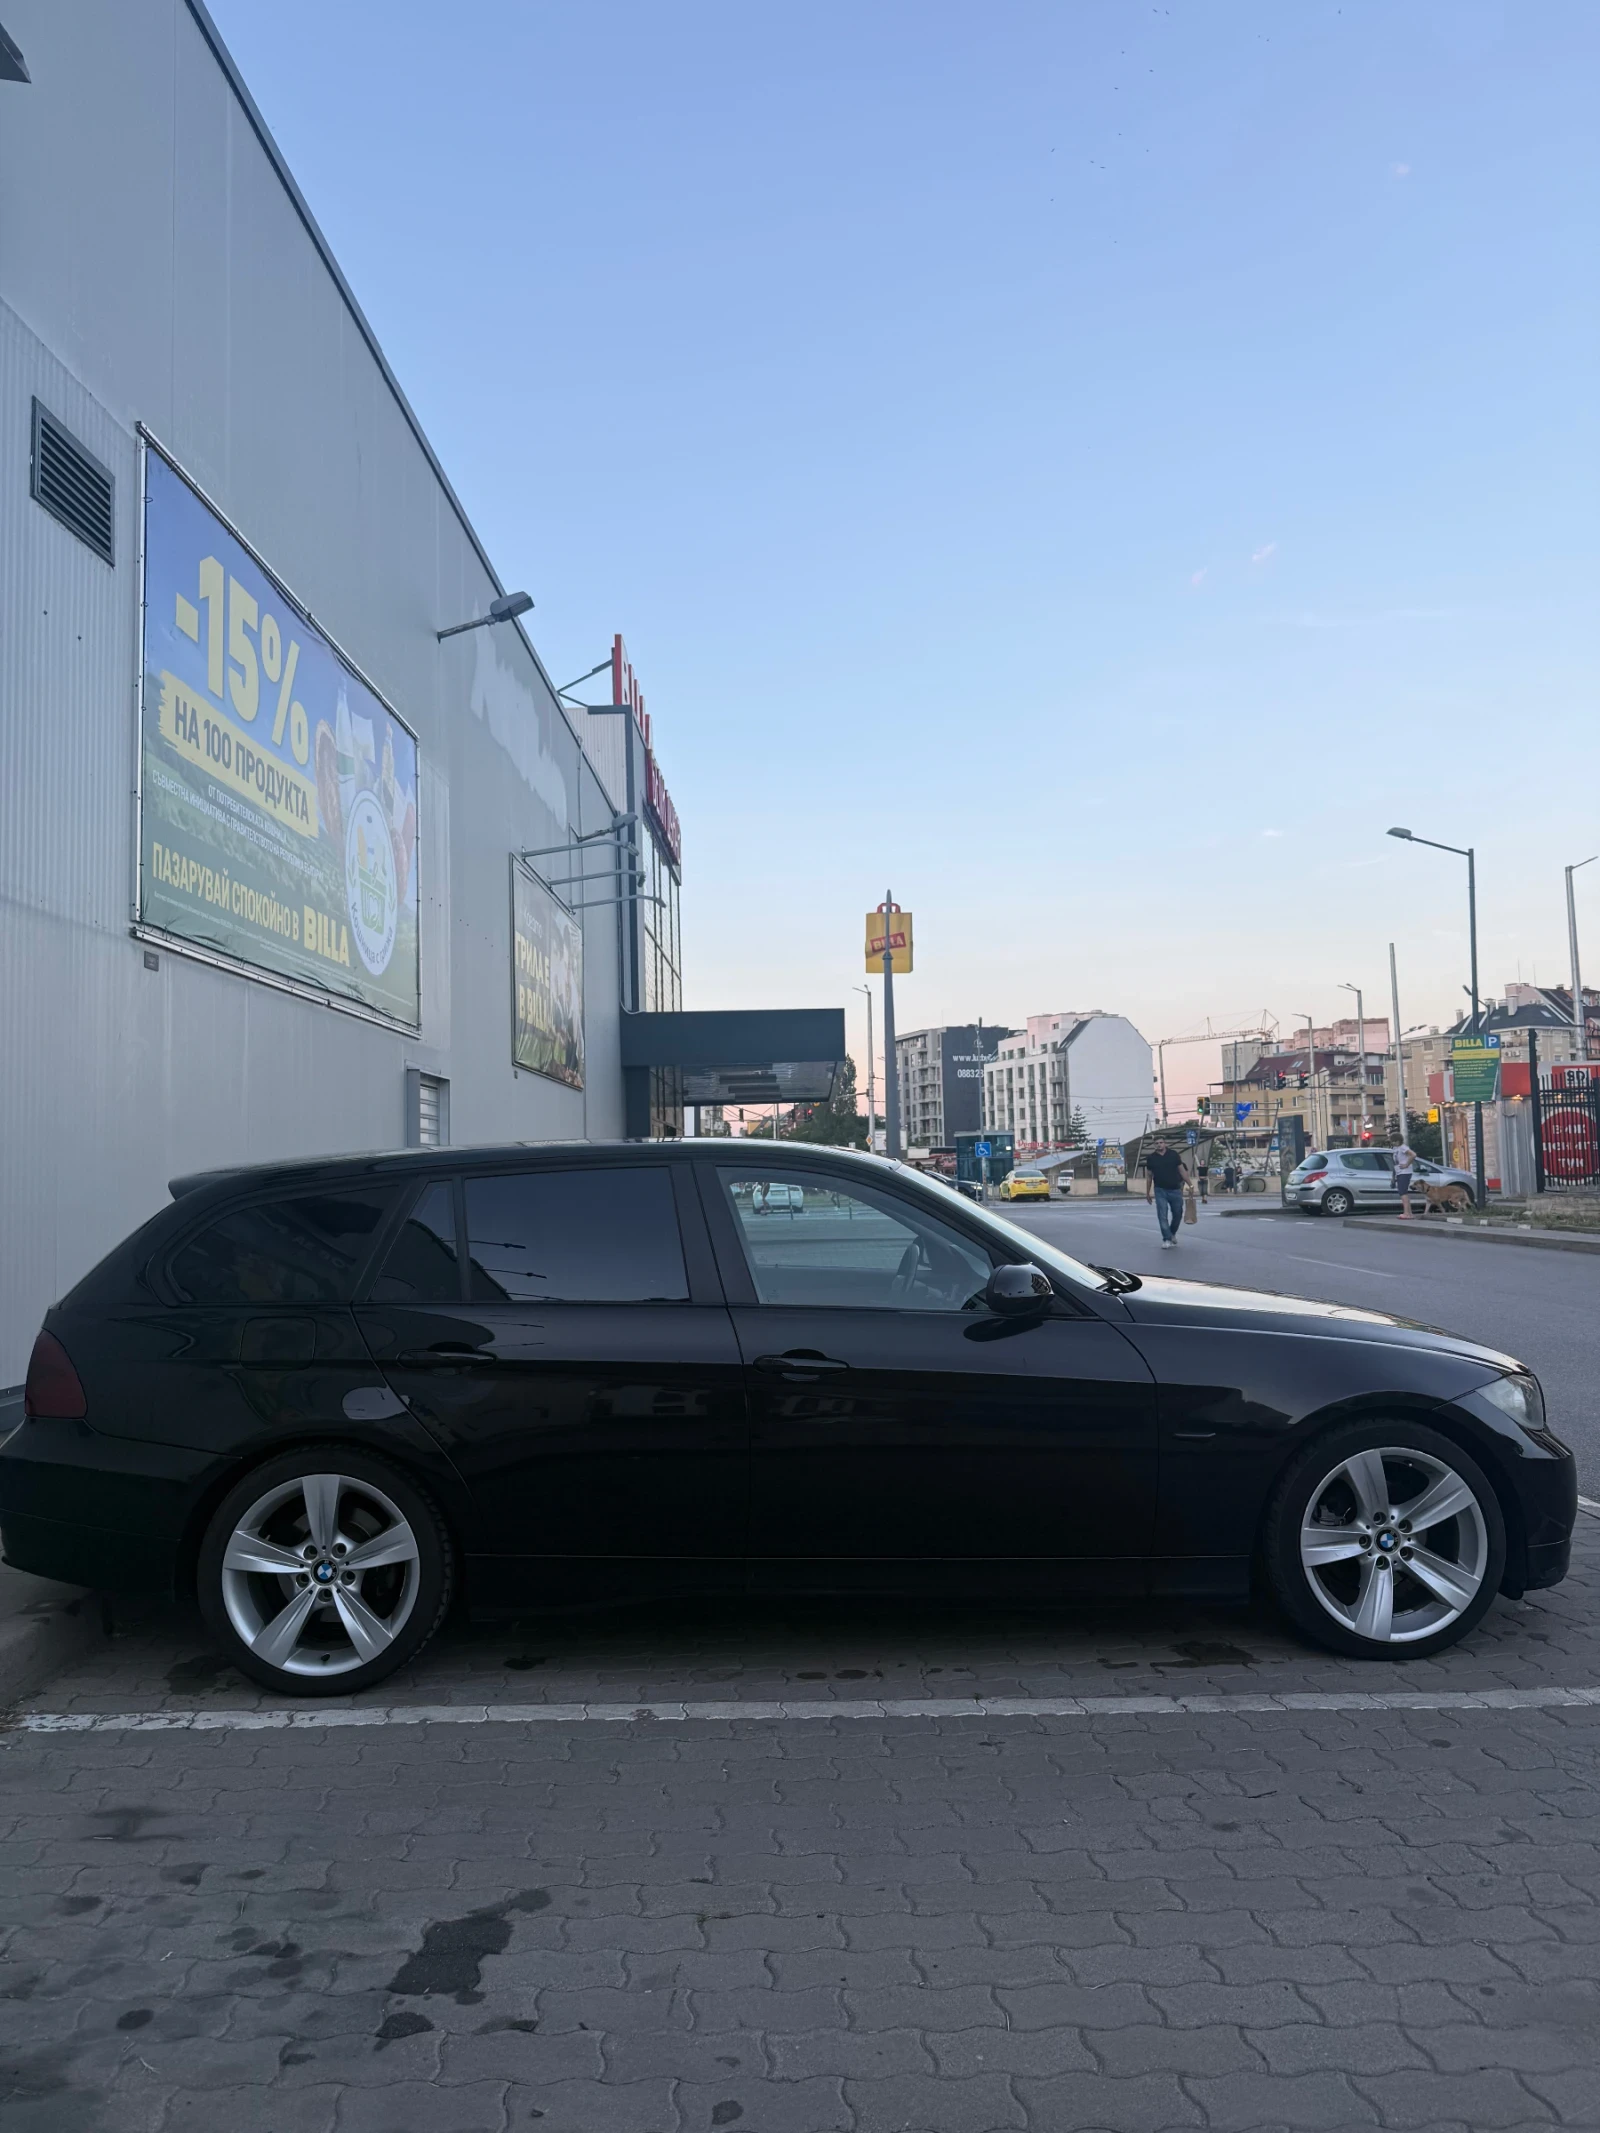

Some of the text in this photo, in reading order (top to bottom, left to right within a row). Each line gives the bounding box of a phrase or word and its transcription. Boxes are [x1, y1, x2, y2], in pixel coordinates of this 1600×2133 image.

[176, 556, 308, 765] -15%
[175, 695, 309, 824] НА 100 ПРОДУКТА
[153, 841, 230, 911] ПАЗАРУВАЙ
[232, 881, 291, 938] СПОКОЙНО
[304, 904, 350, 967] BILLA
[515, 930, 544, 985] ГРИЛА
[1454, 1038, 1483, 1048] BILLA
